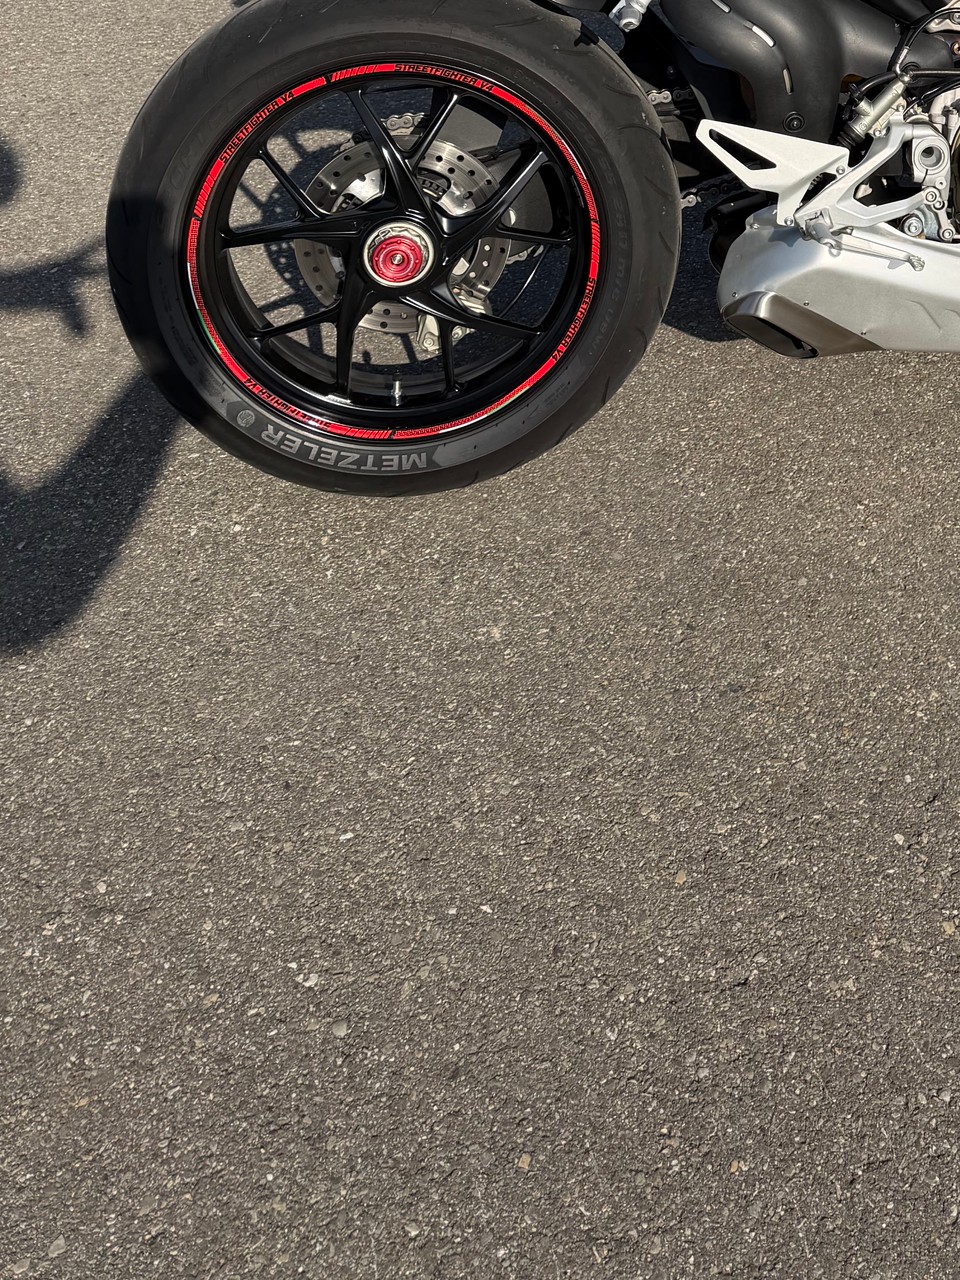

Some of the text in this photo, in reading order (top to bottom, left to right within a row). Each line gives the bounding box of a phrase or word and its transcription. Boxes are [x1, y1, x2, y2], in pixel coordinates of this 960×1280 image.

[394, 63, 494, 93] STREETFIGHTER V4
[219, 91, 294, 162] STREETFIGHTER V4
[561, 277, 596, 348] STREETFIGHTER
[551, 349, 564, 362] V4
[244, 377, 256, 391] V4
[260, 423, 428, 471] METZELER
